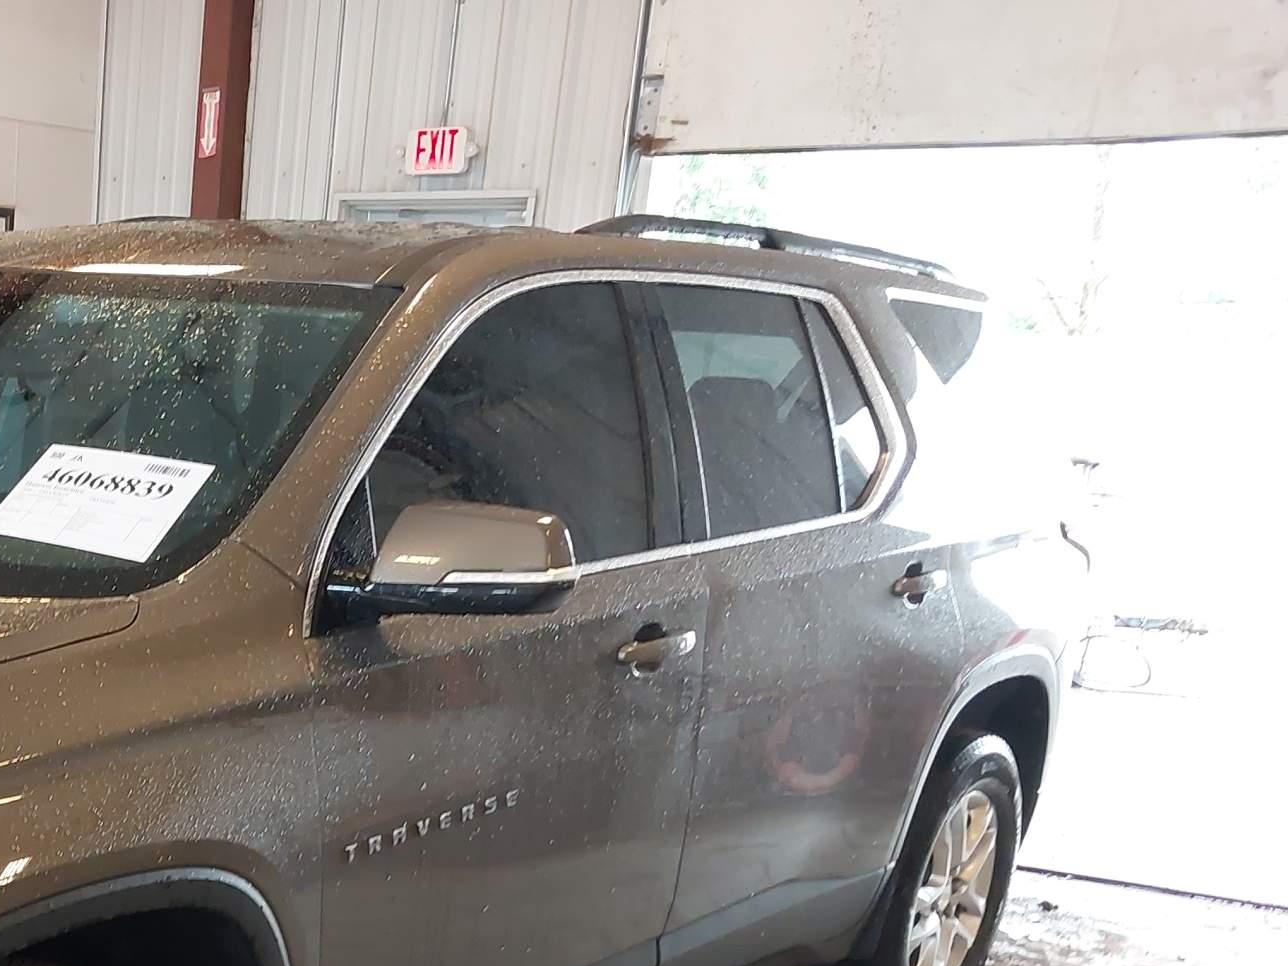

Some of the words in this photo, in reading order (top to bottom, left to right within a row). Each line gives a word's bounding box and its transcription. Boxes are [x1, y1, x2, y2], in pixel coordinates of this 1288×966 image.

[415, 129, 459, 170] EXIT
[43, 467, 174, 500] 46068839
[344, 788, 519, 864] TRAVERSE
